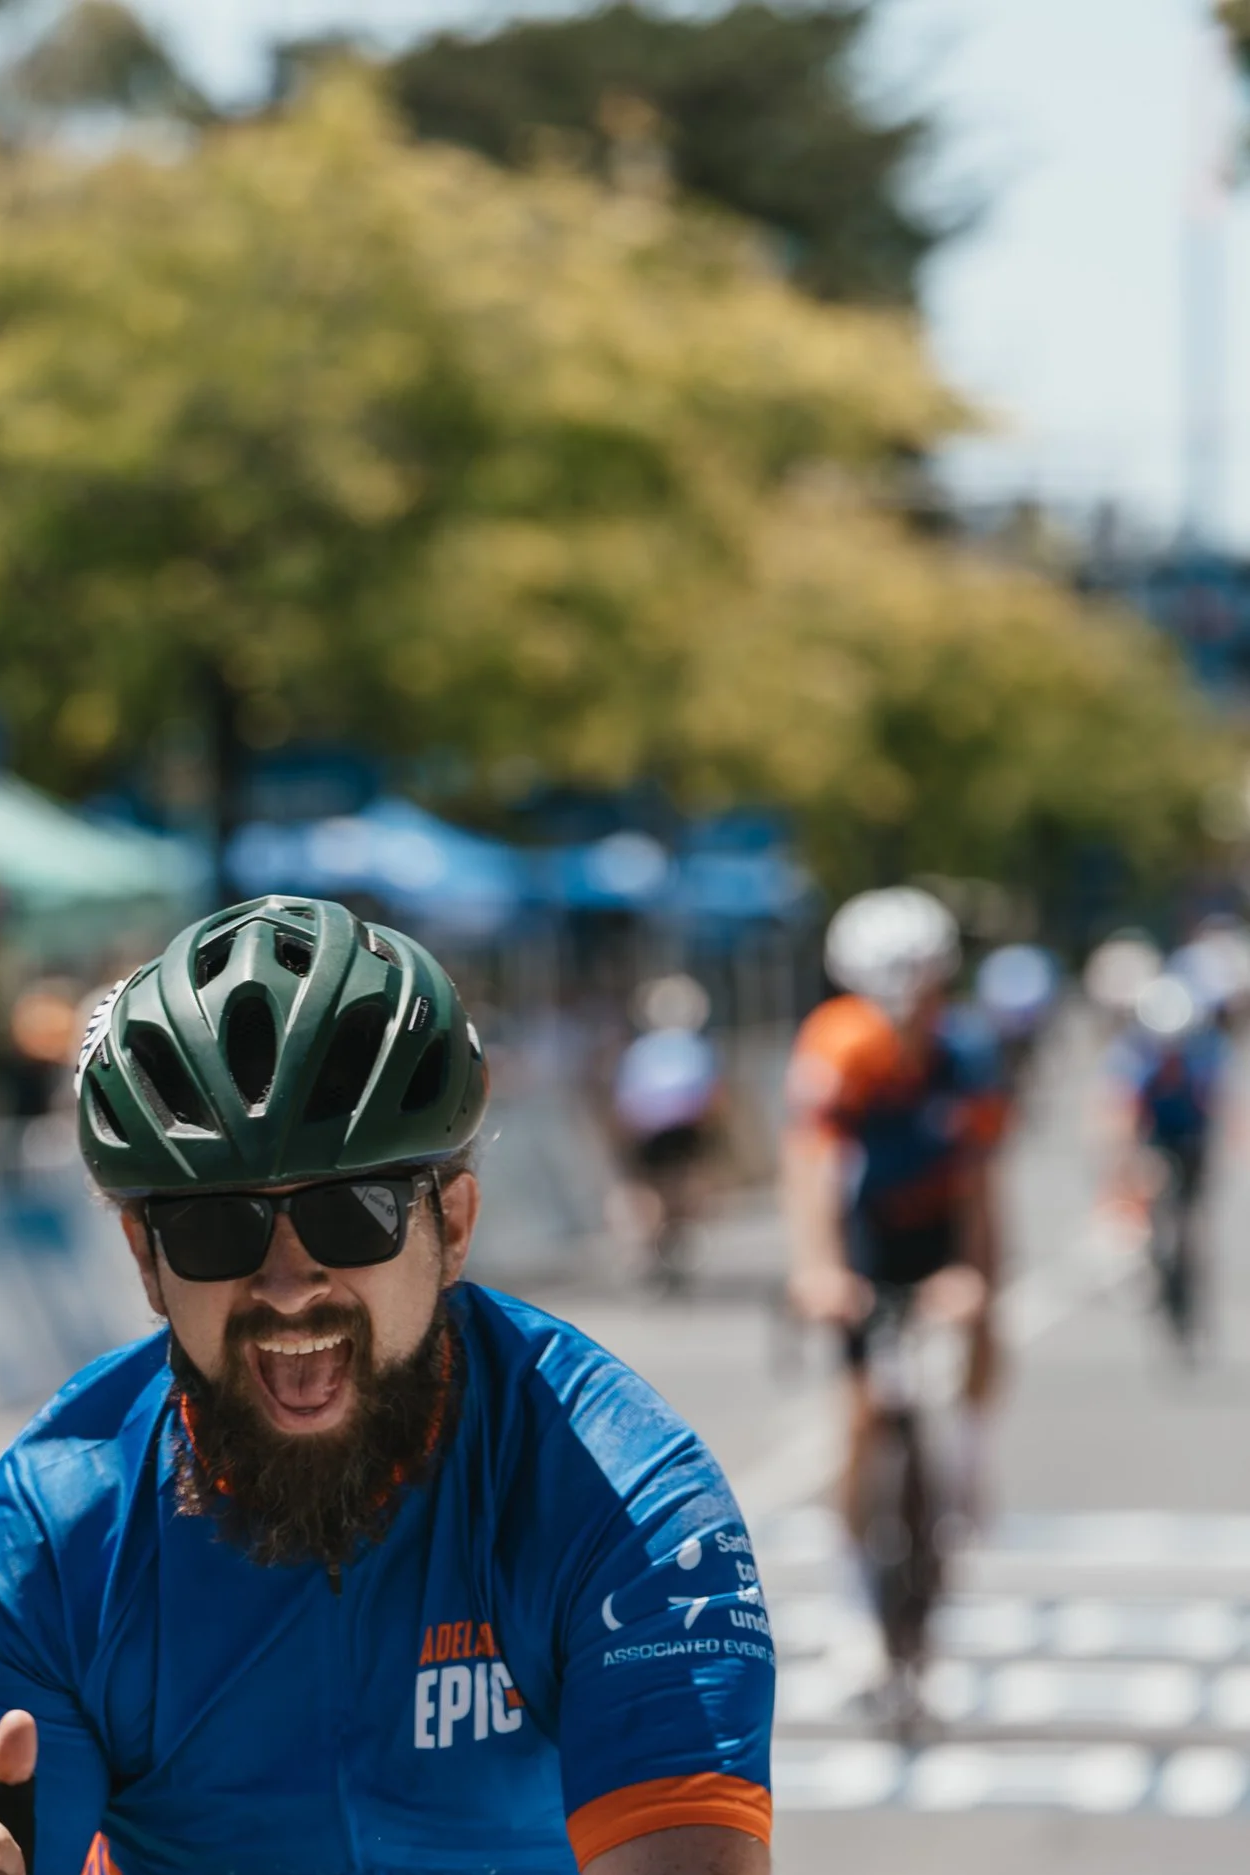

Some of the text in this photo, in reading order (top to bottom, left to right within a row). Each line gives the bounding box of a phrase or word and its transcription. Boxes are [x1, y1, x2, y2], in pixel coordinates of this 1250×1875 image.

[418, 1620, 499, 1667] ADELA
[603, 1638, 720, 1667] ASSOCIATED
[414, 1662, 524, 1749] EPIC
